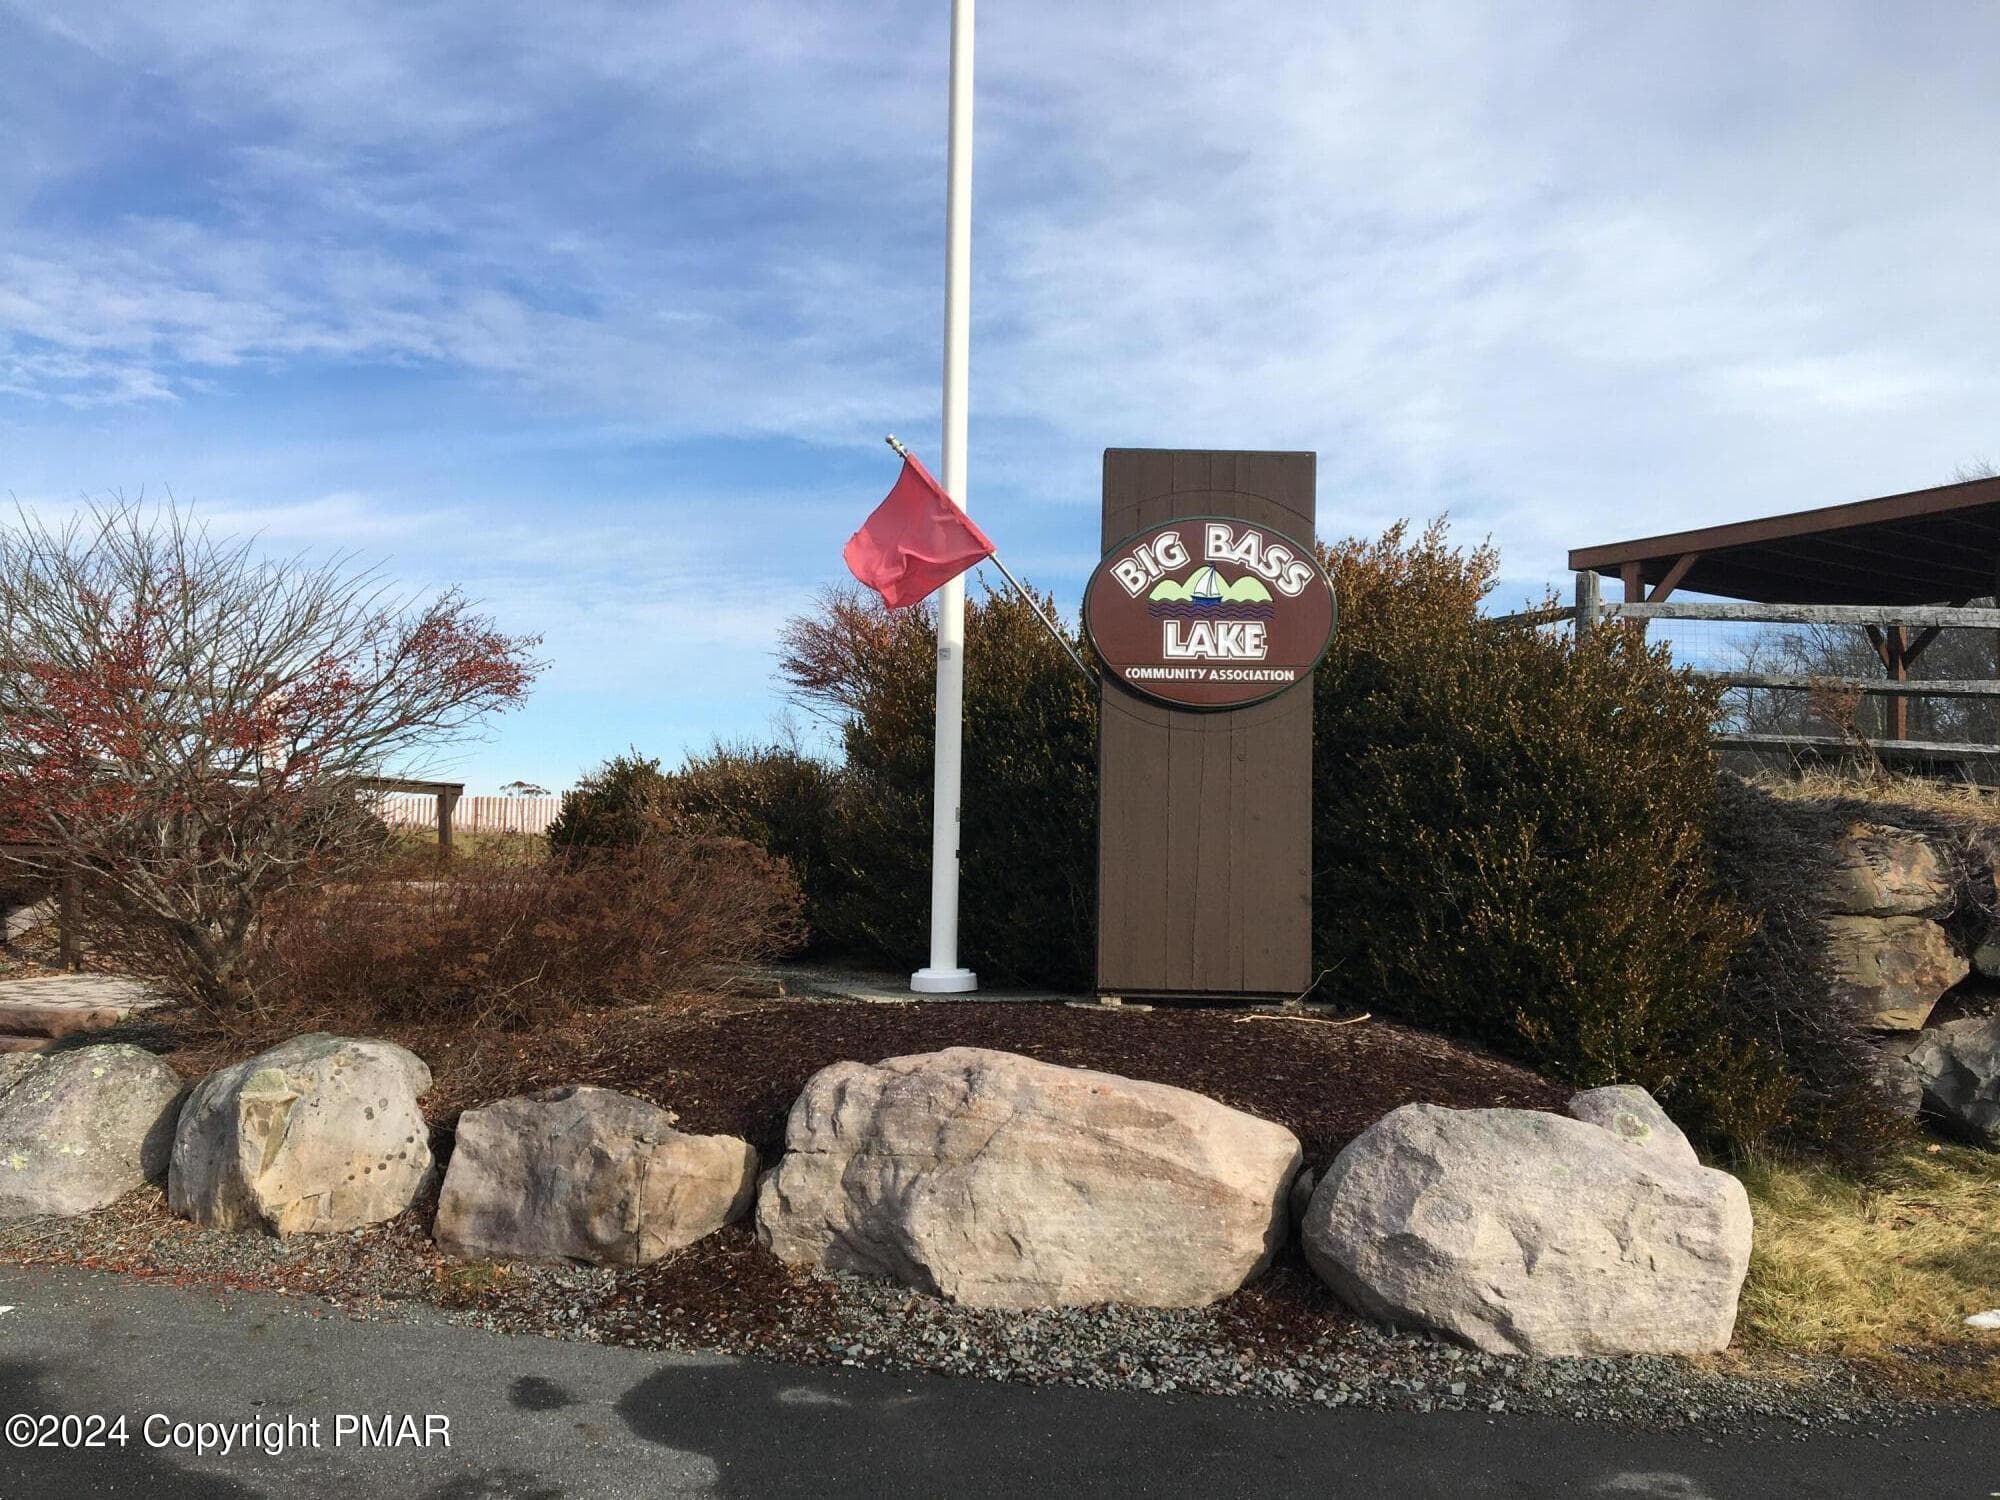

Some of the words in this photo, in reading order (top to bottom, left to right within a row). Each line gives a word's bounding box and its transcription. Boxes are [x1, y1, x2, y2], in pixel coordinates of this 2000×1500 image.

[1110, 531, 1191, 598] BIG
[1204, 523, 1315, 597] BASS
[1163, 620, 1268, 660] LAKE
[1125, 667, 1205, 681] COMMUNITY
[1209, 669, 1295, 682] ASSOCIATION
